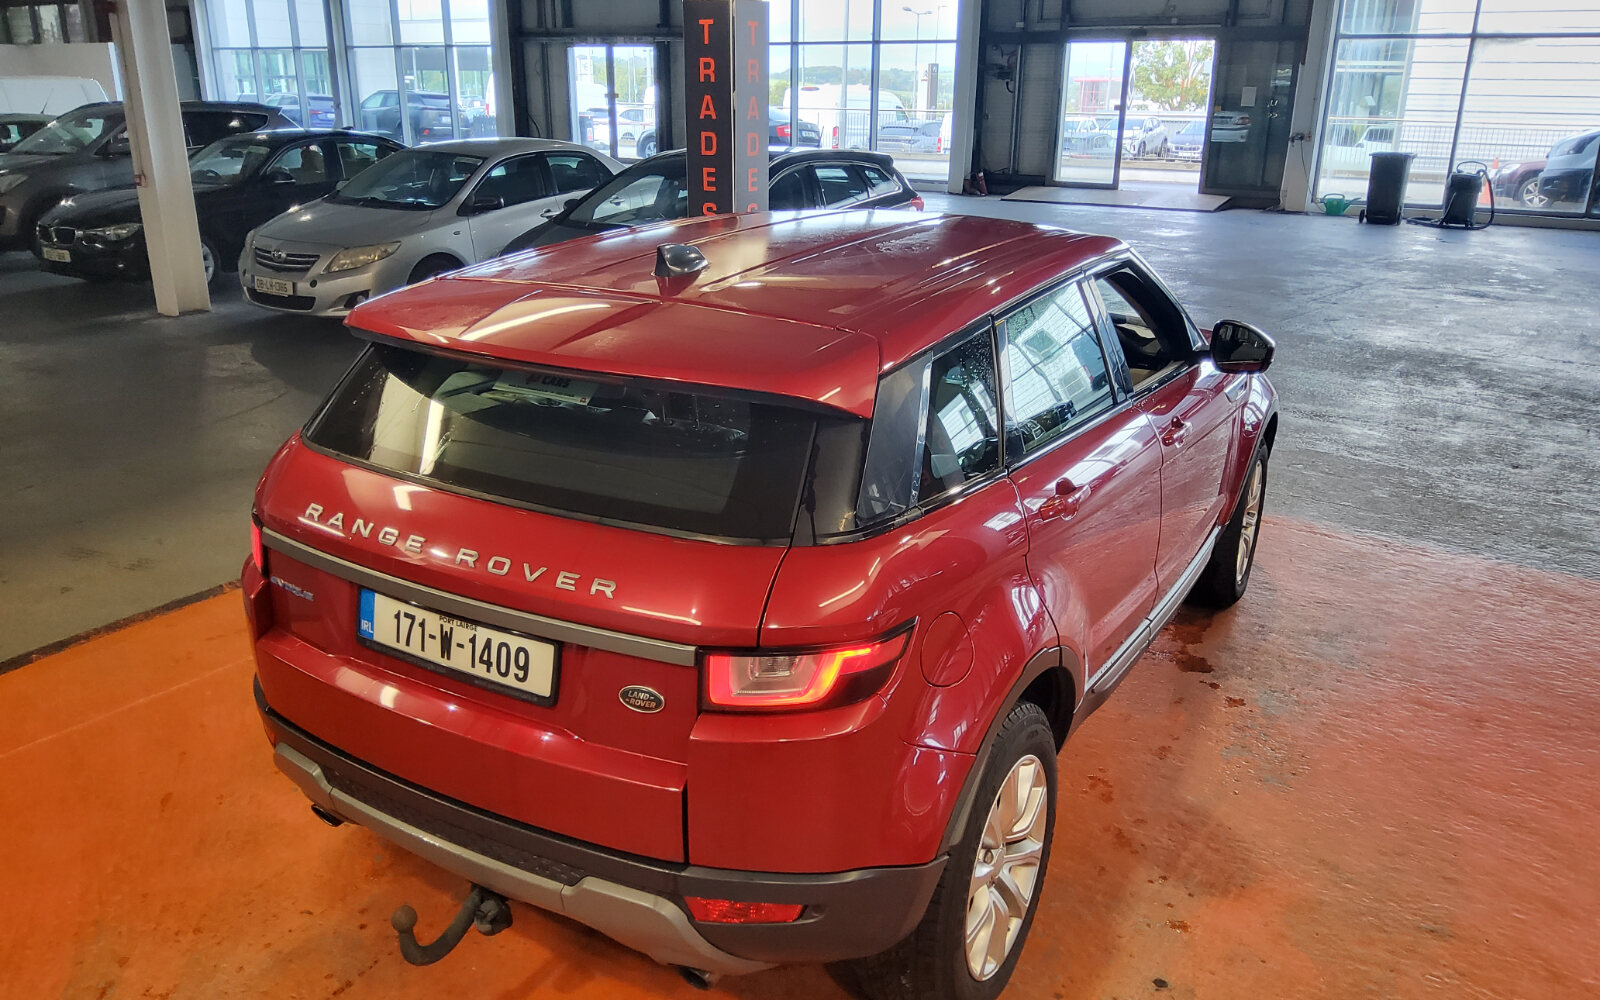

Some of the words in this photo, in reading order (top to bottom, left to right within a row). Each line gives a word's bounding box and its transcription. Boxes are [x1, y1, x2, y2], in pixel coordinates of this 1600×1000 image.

[304, 502, 427, 554] RANGE
[455, 547, 618, 600] ROVER
[361, 619, 374, 633] IRL
[439, 615, 455, 625] PORT
[394, 609, 530, 683] 171-W-1409
